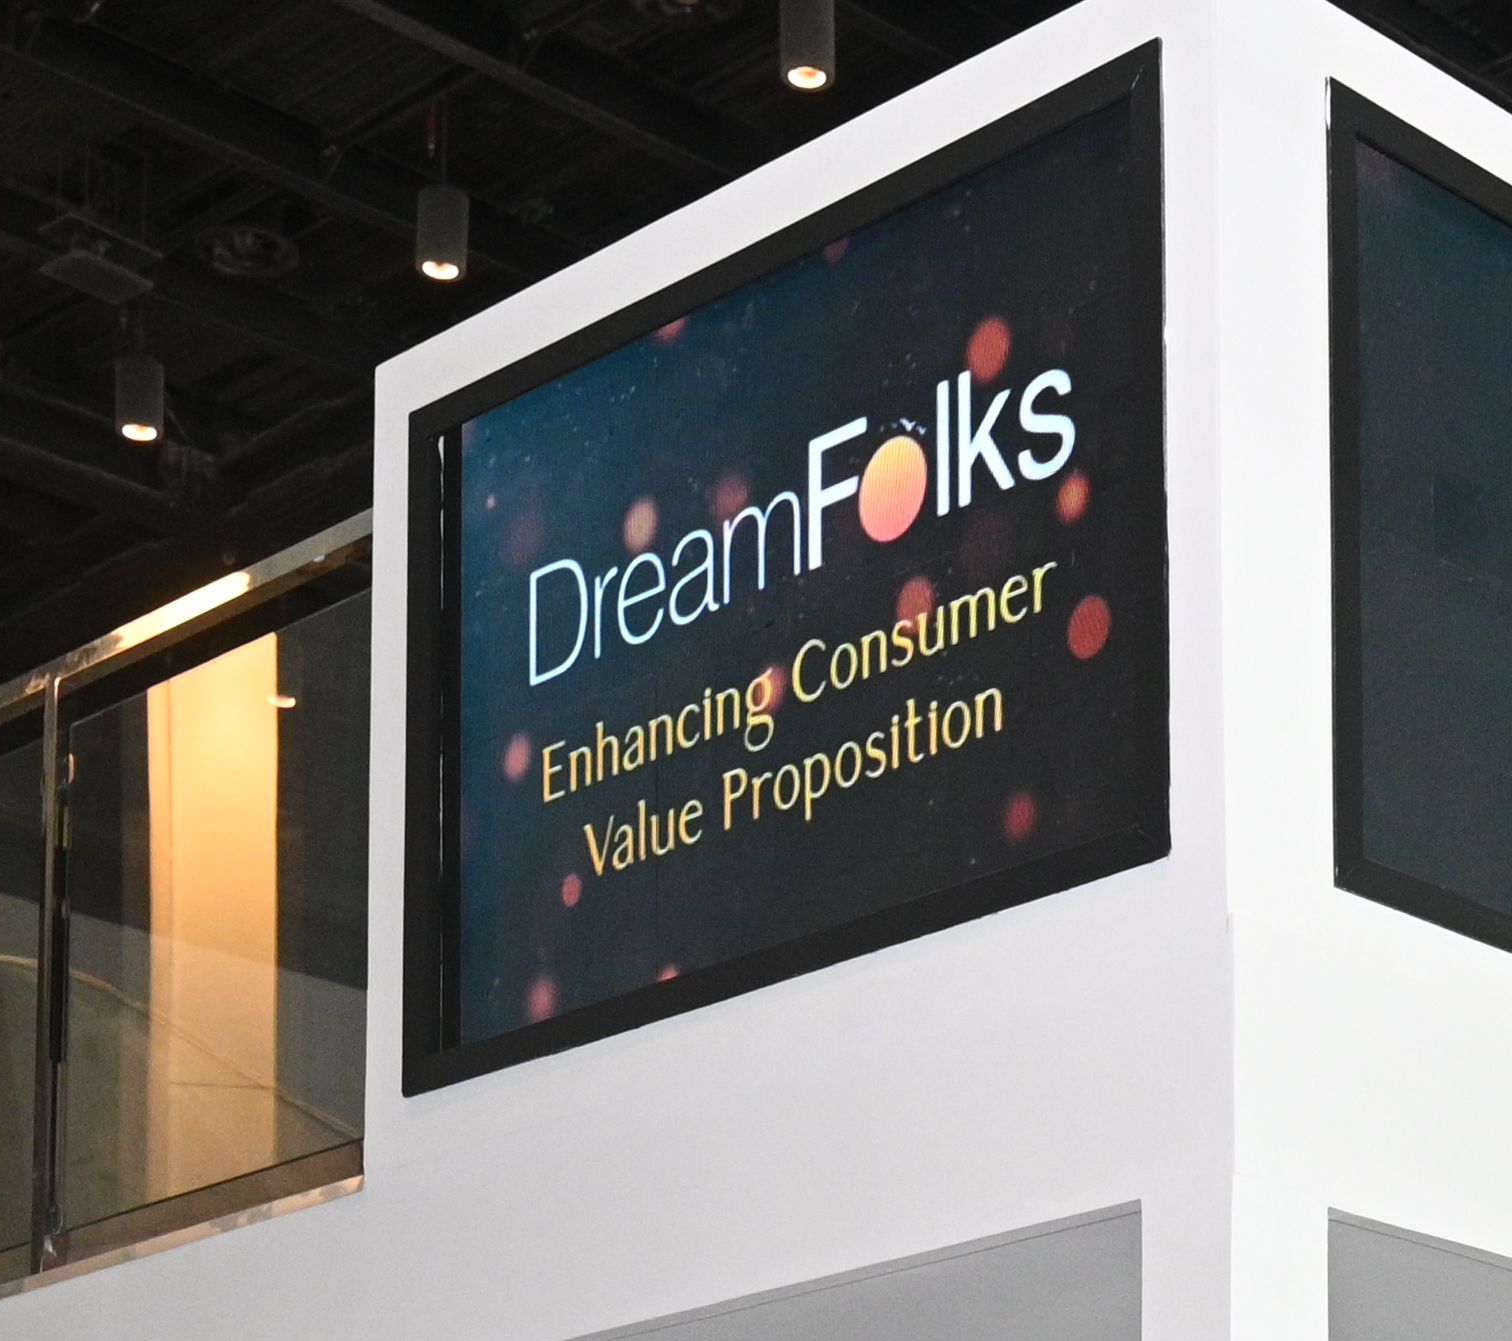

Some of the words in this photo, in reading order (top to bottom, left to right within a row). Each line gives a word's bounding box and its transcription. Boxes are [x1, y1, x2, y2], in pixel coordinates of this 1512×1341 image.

[528, 367, 1077, 687] DreamFolks
[541, 665, 775, 805] Enhancing
[792, 560, 1058, 704] Consumer
[583, 786, 703, 879] Value
[722, 684, 1004, 833] Proposition
